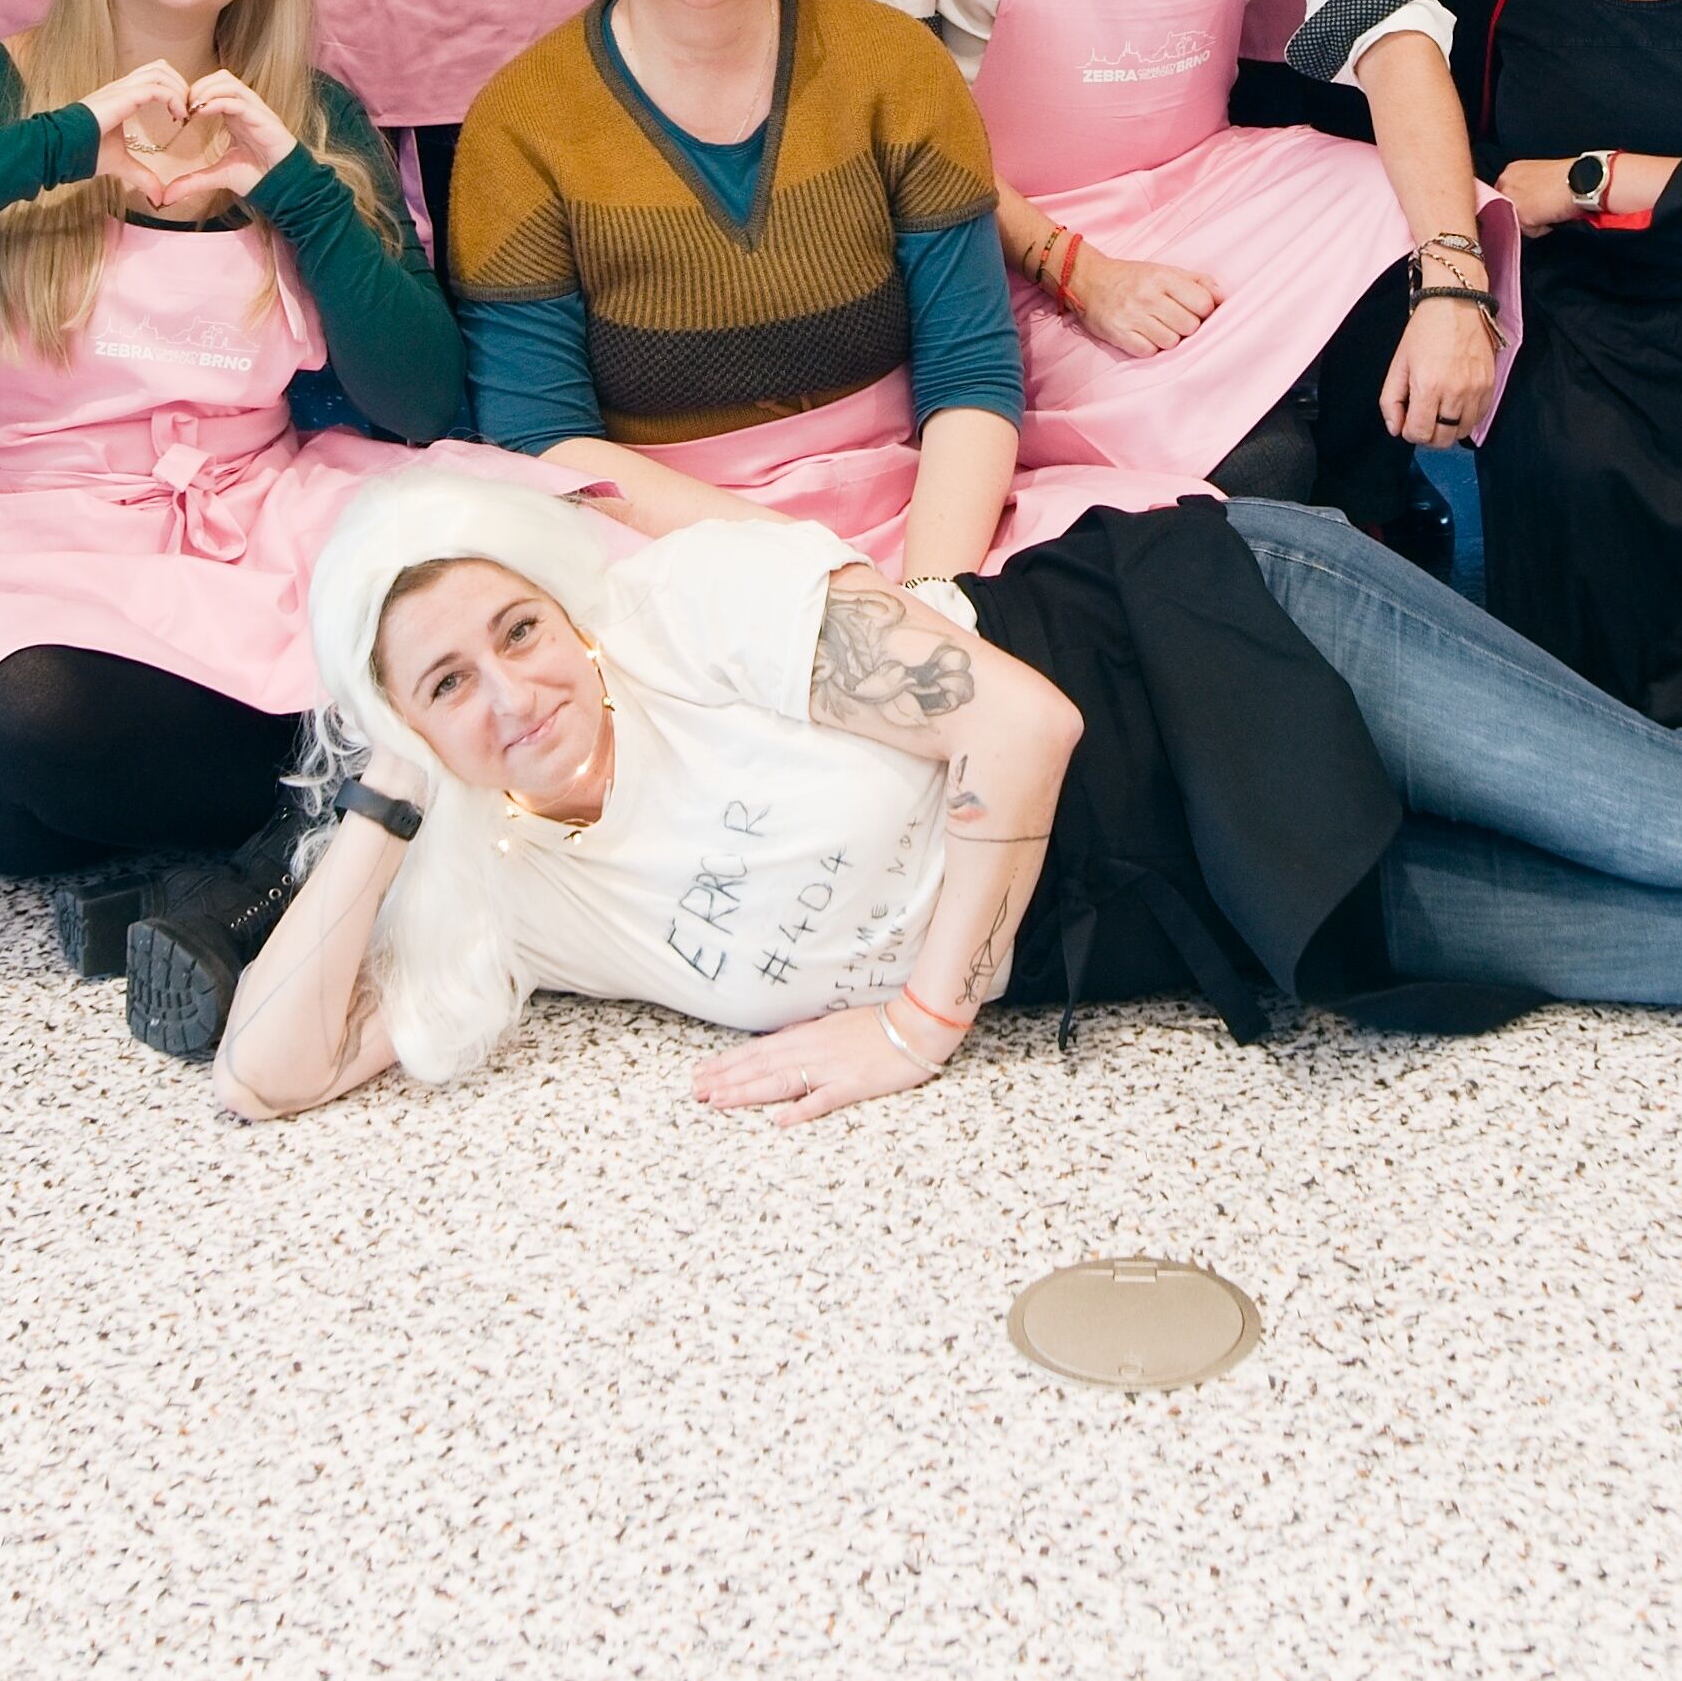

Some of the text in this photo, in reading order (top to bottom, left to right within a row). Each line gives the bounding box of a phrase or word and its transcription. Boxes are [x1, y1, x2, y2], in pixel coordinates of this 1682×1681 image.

[1083, 50, 1211, 83] ZEBRA BRNO
[94, 341, 155, 361] ZEBRA
[199, 352, 252, 371] BRNO
